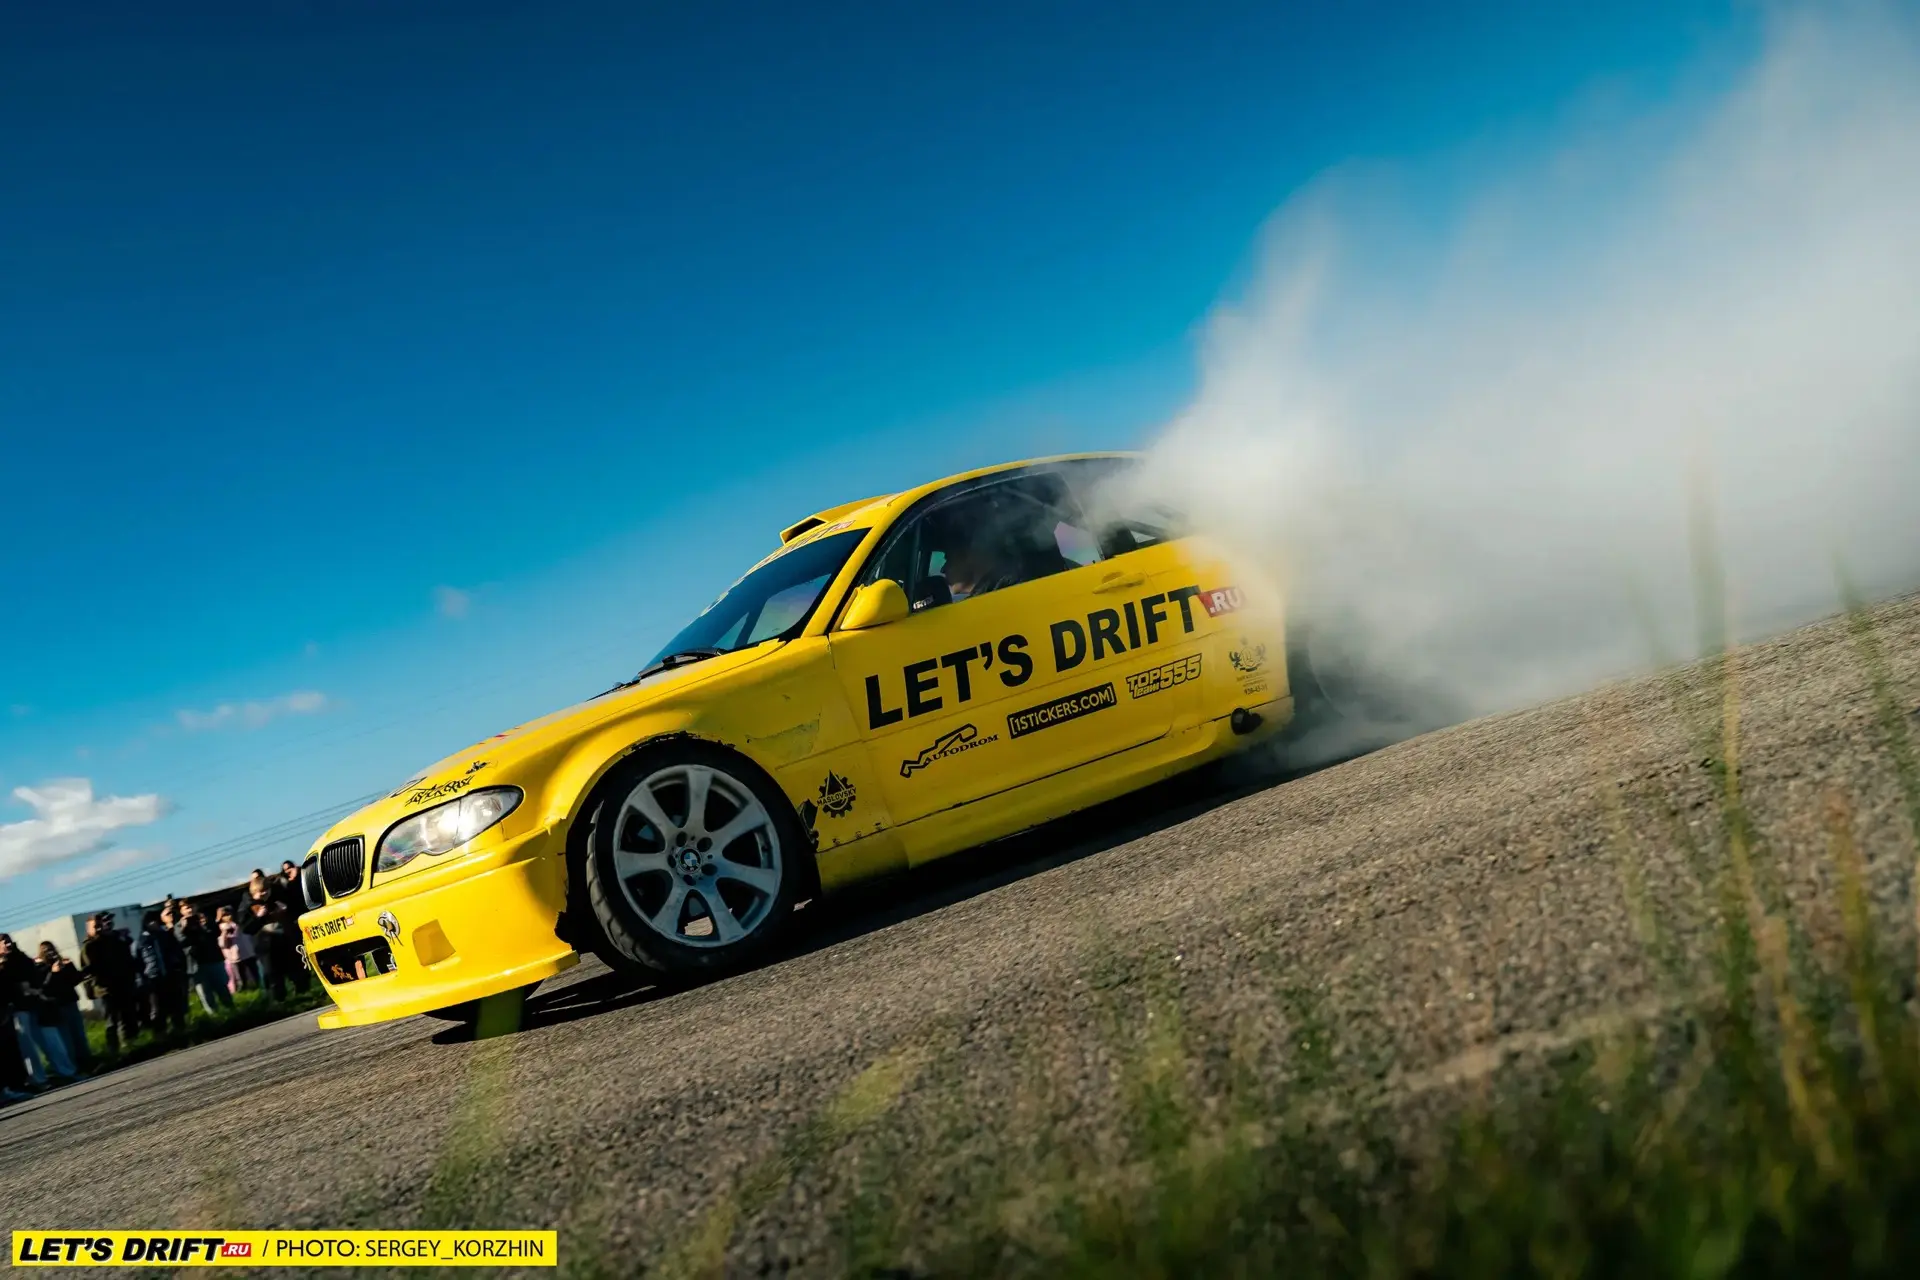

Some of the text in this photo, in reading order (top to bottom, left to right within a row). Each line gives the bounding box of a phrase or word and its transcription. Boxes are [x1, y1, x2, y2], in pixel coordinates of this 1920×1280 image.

[865, 633, 1034, 730] LET'S
[1126, 667, 1161, 692] TOP
[1159, 653, 1202, 690] 555
[922, 733, 999, 768] AUTODROM
[816, 786, 857, 806] MASLOVSKY
[324, 916, 347, 936] DRIFT
